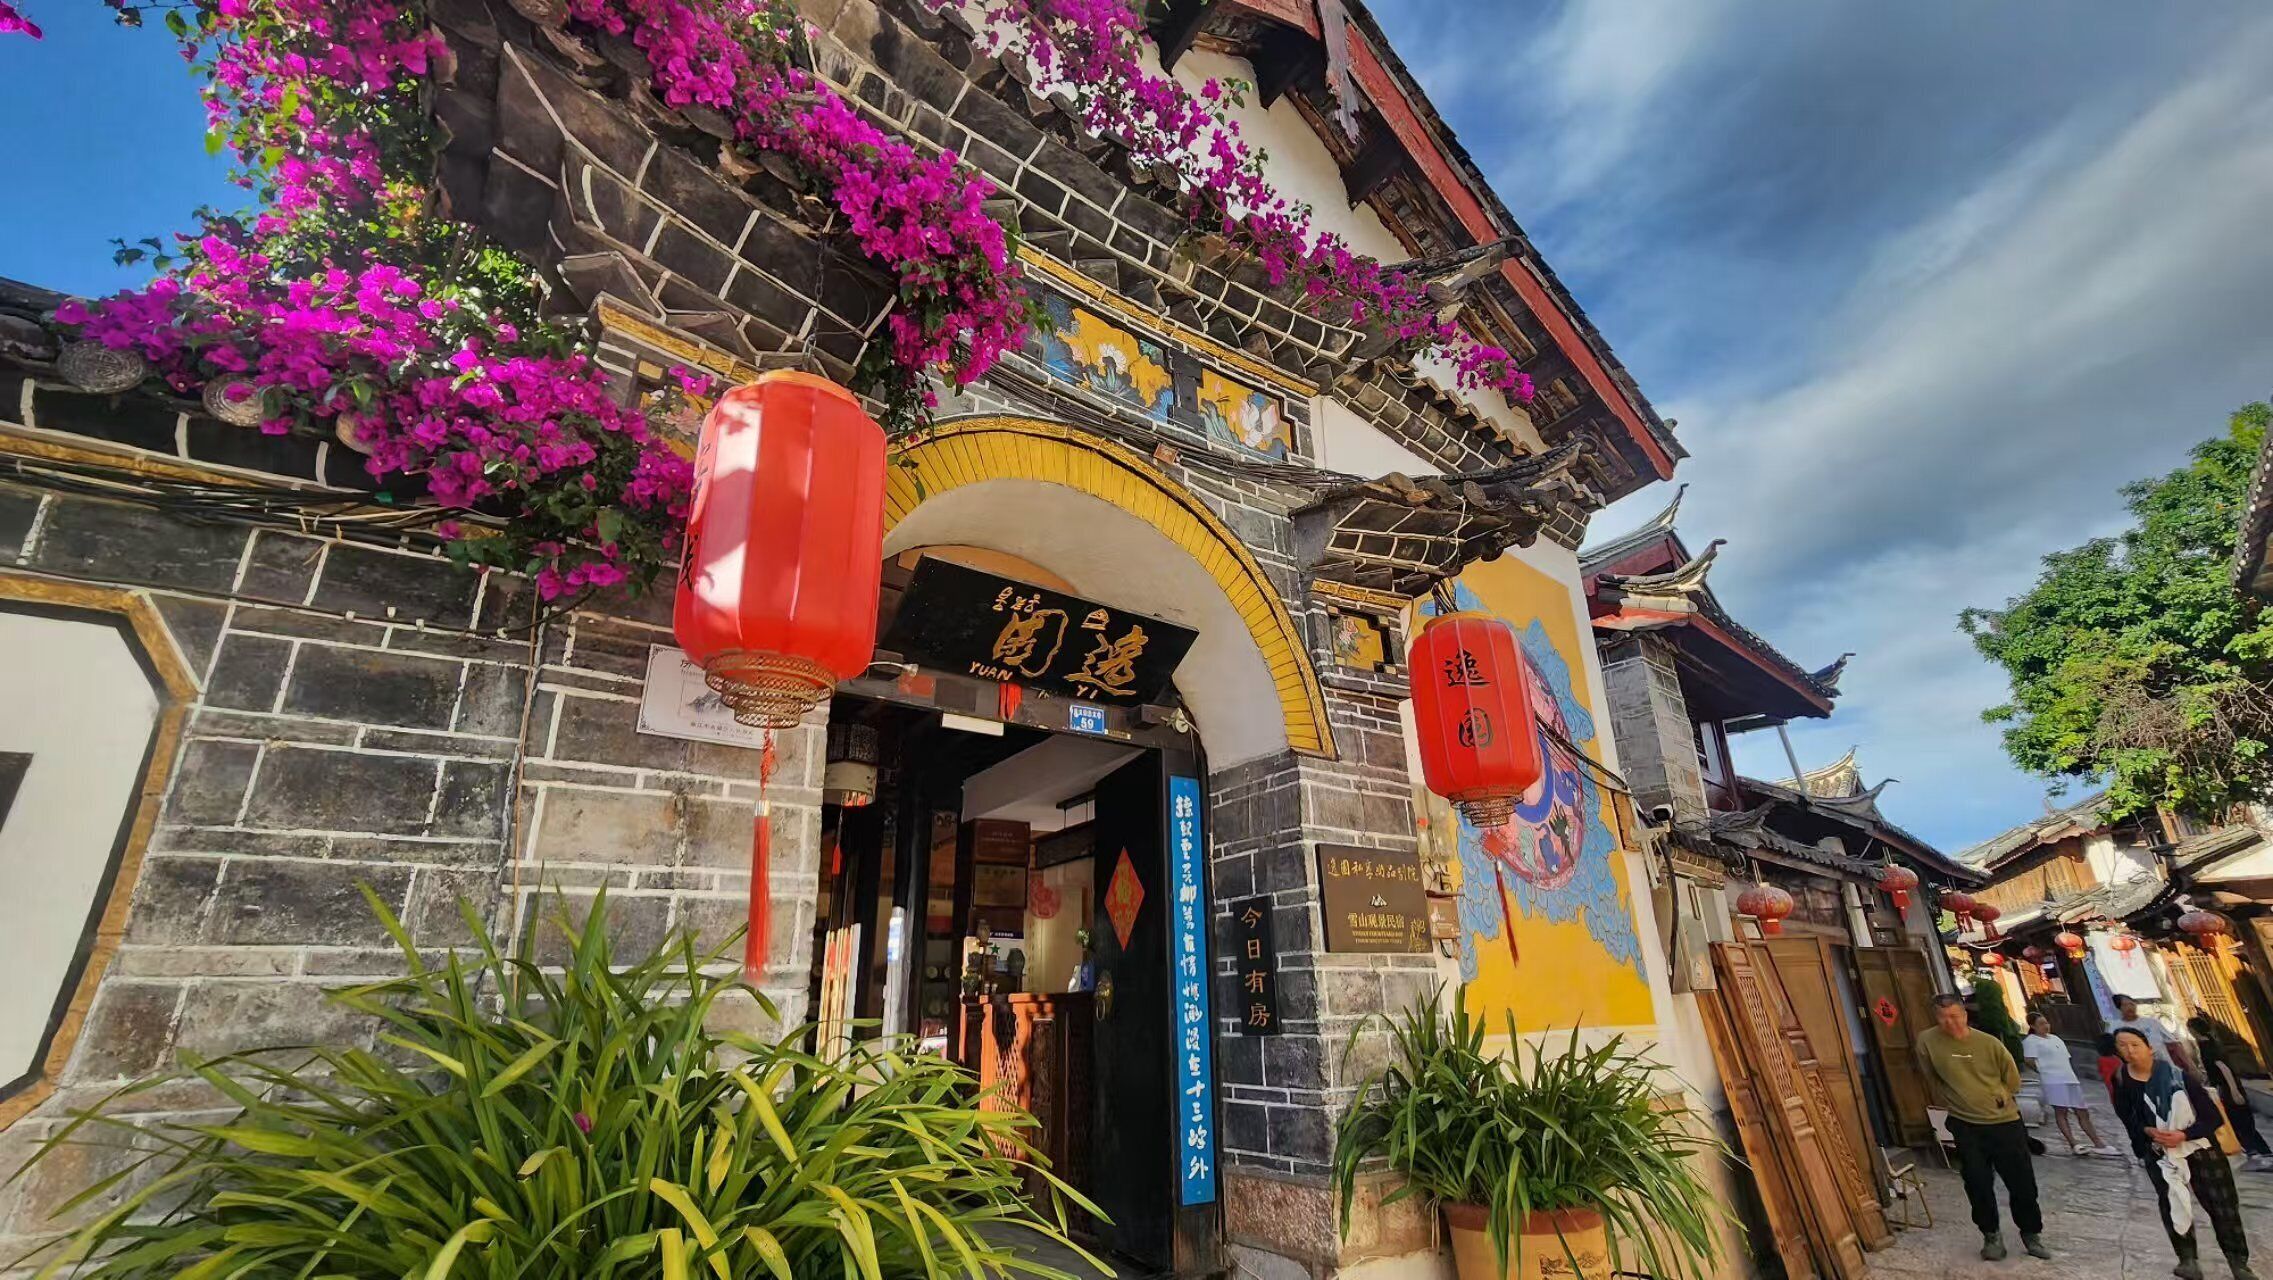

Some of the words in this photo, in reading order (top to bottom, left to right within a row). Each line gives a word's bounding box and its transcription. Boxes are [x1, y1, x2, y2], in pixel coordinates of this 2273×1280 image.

[968, 660, 1014, 681] YUAN
[1076, 684, 1099, 700] YI
[1080, 716, 1095, 730] 59
[1347, 912, 1405, 930] 雪山观景民宿
[1240, 905, 1272, 1028] 今日有房
